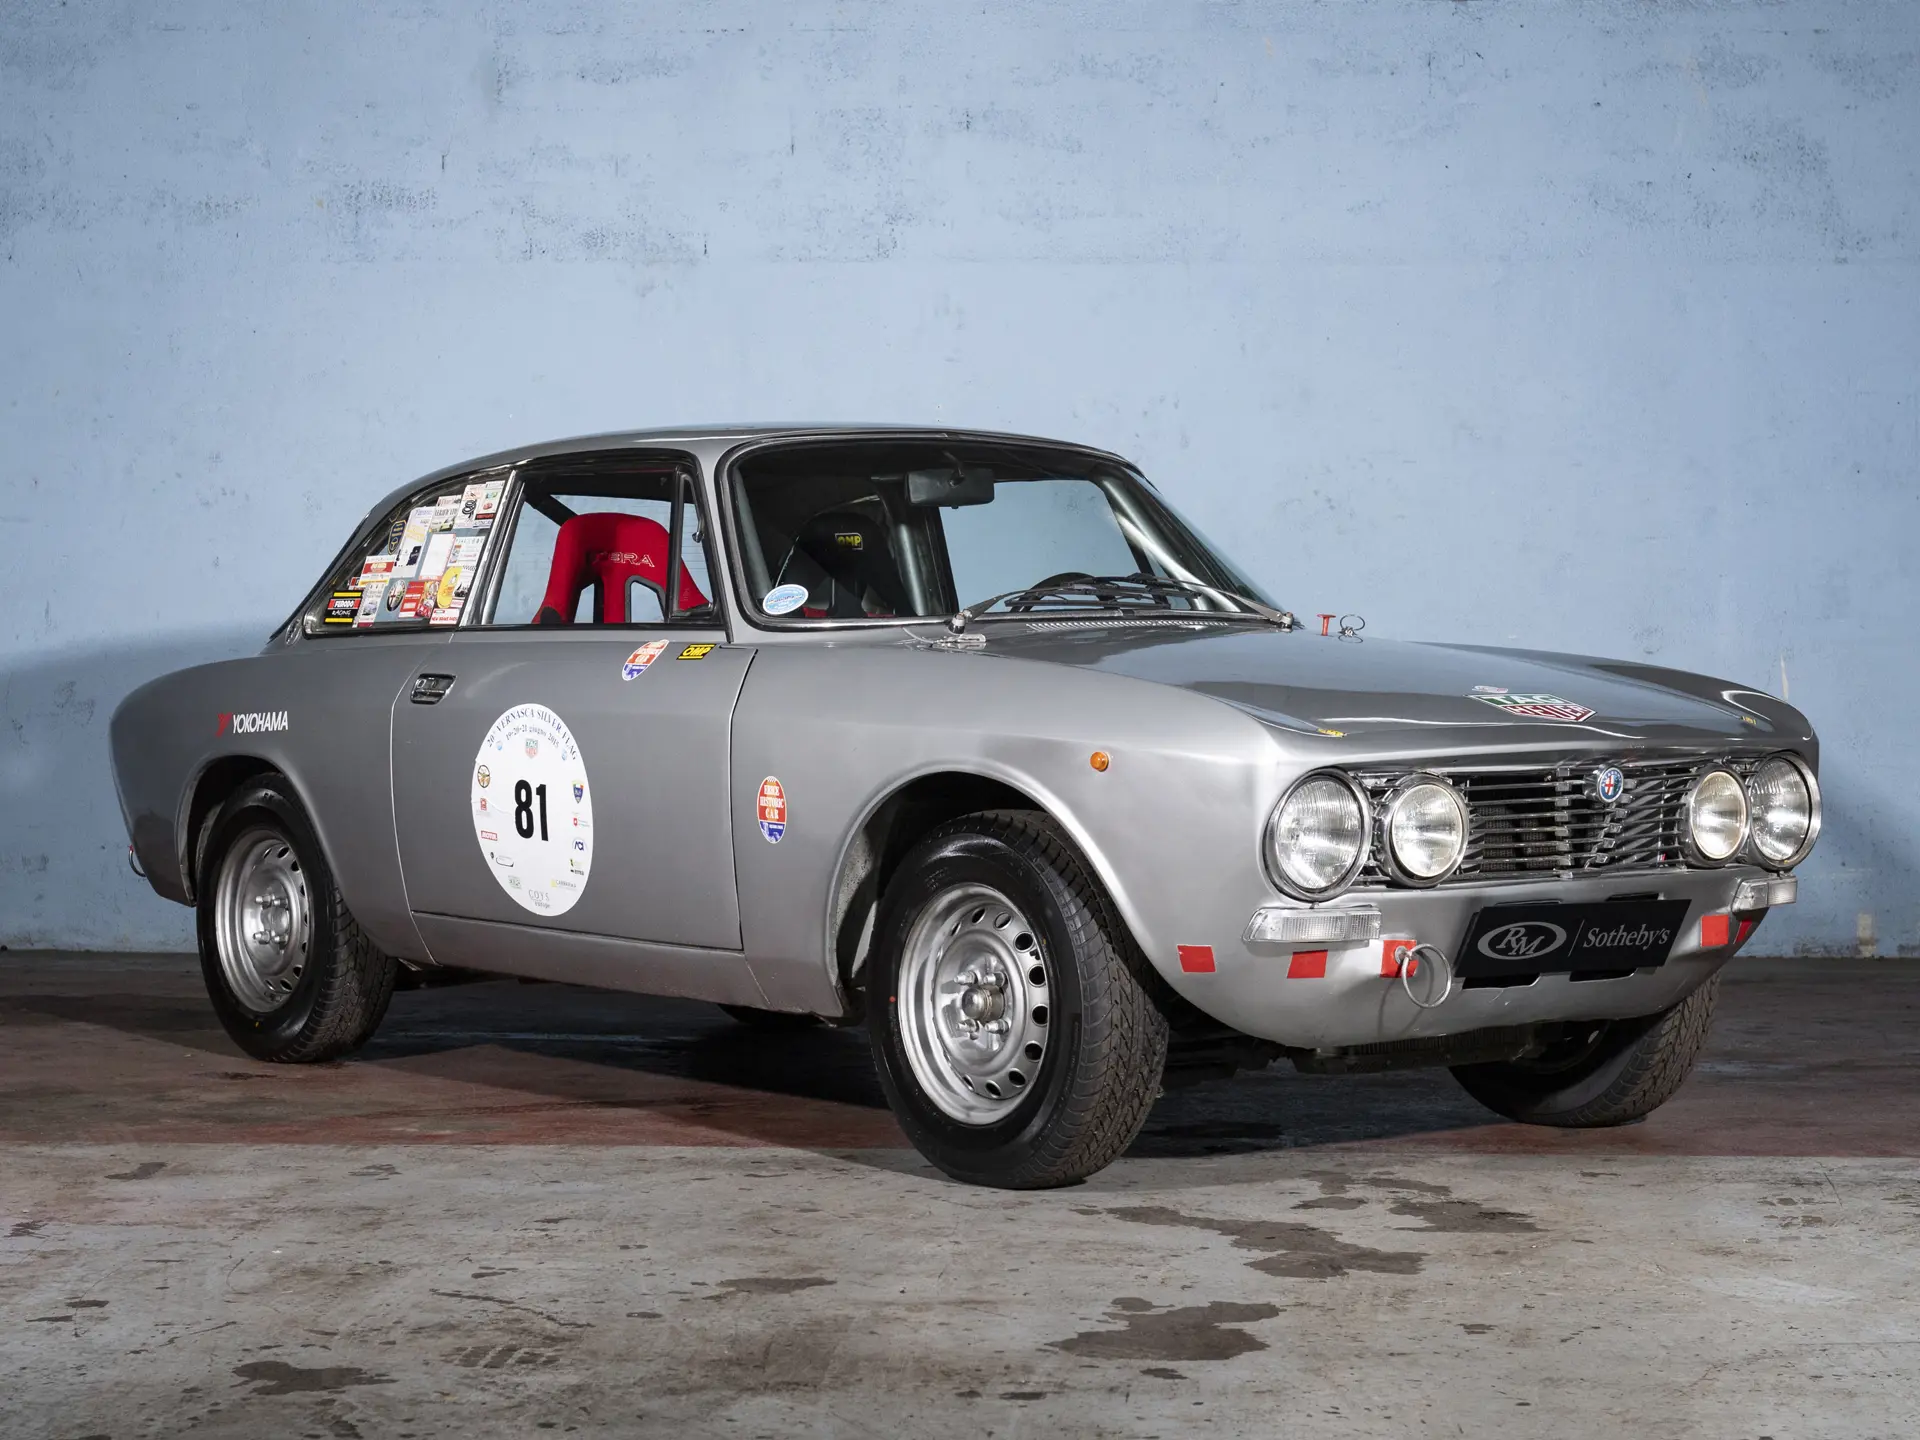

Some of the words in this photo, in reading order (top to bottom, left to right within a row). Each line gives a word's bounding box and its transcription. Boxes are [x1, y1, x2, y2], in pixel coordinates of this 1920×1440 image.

[682, 646, 712, 656] OMP
[1479, 694, 1564, 704] TAG
[1504, 704, 1590, 720] HEUER
[233, 711, 288, 734] YOKOHAMA
[496, 708, 534, 732] VERNASCA
[537, 709, 562, 733] SILVER
[562, 731, 578, 760] FLAG
[515, 779, 548, 841] 81
[765, 808, 779, 819] CAR
[528, 889, 550, 901] COYS
[1496, 927, 1545, 955] RM
[1582, 923, 1671, 950] Sotheby's
